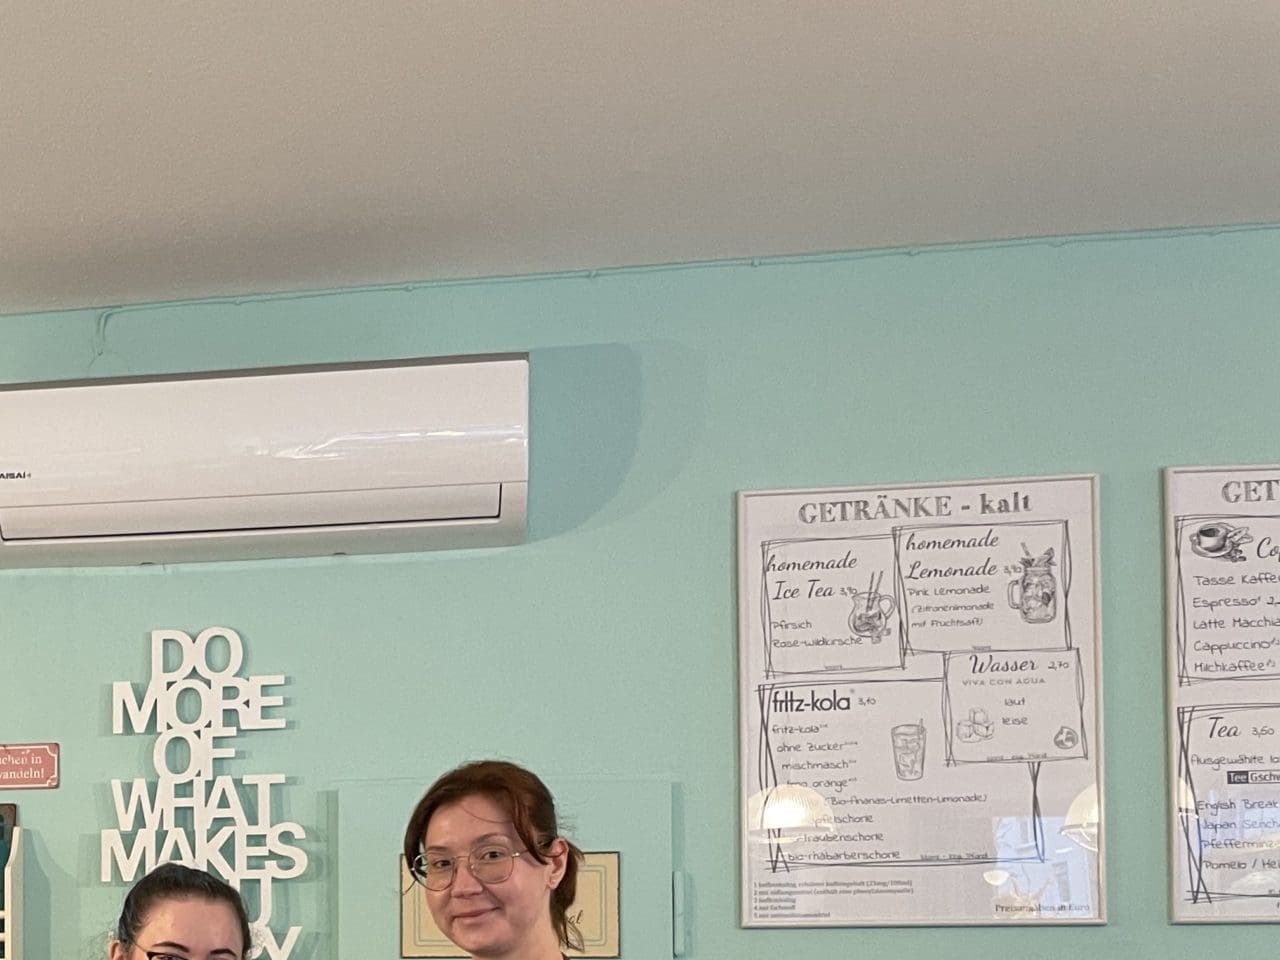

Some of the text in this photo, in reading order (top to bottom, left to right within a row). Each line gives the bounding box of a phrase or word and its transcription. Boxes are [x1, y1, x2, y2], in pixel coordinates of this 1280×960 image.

[798, 495, 952, 524] GETRÄNKE
[980, 491, 1033, 516] kalt
[906, 529, 999, 551] homemade
[766, 551, 857, 572] homemade
[905, 562, 998, 581] Lemonade
[1193, 572, 1280, 585] Tasse Kaffe
[772, 580, 800, 600] Ice
[808, 579, 835, 599] Tea
[907, 588, 929, 596] Pink
[771, 619, 812, 629] Pfirsich
[1193, 618, 1225, 629] Latte
[151, 626, 243, 681] DO
[969, 654, 1039, 674] Wasser
[112, 675, 286, 734] MORE
[1208, 717, 1241, 738] Tea
[153, 726, 237, 784] OF
[776, 742, 801, 752] ohne
[31, 752, 42, 765] in
[1230, 773, 1248, 782] Tee
[111, 773, 285, 831] WHAT
[1202, 820, 1236, 834] Japan
[100, 822, 308, 882] MAKES
[1202, 860, 1247, 870] Pomelo
